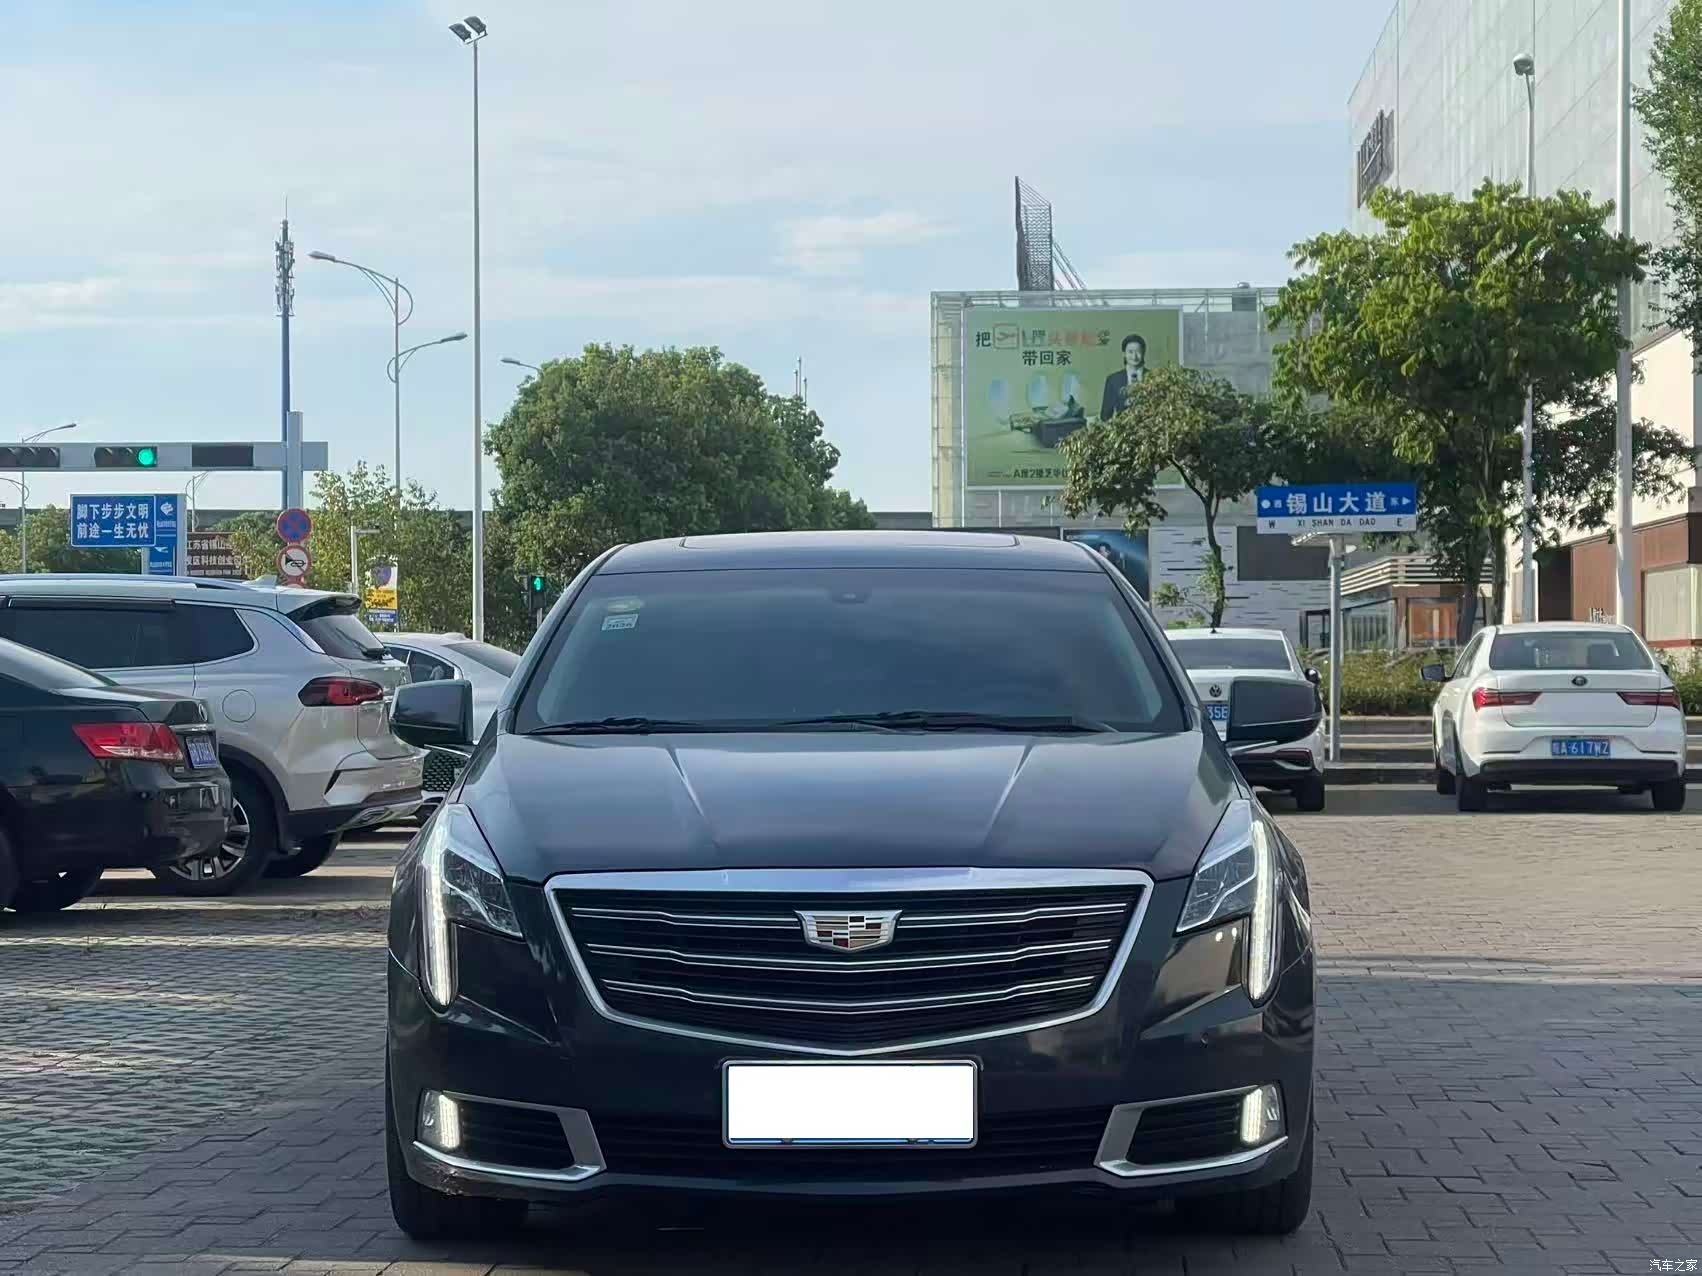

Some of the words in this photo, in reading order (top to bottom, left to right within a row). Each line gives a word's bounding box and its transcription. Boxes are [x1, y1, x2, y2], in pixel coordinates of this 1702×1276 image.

[1022, 350, 1071, 366] 带回家
[1287, 491, 1386, 514] 锡山大道
[76, 503, 149, 520] 脚下步步文明
[76, 523, 149, 539] 前途一生无忧
[1268, 520, 1276, 529] W
[1312, 519, 1334, 527] SHAN
[1341, 518, 1352, 526] DA
[1360, 517, 1376, 526] DAO
[1396, 518, 1403, 527] E
